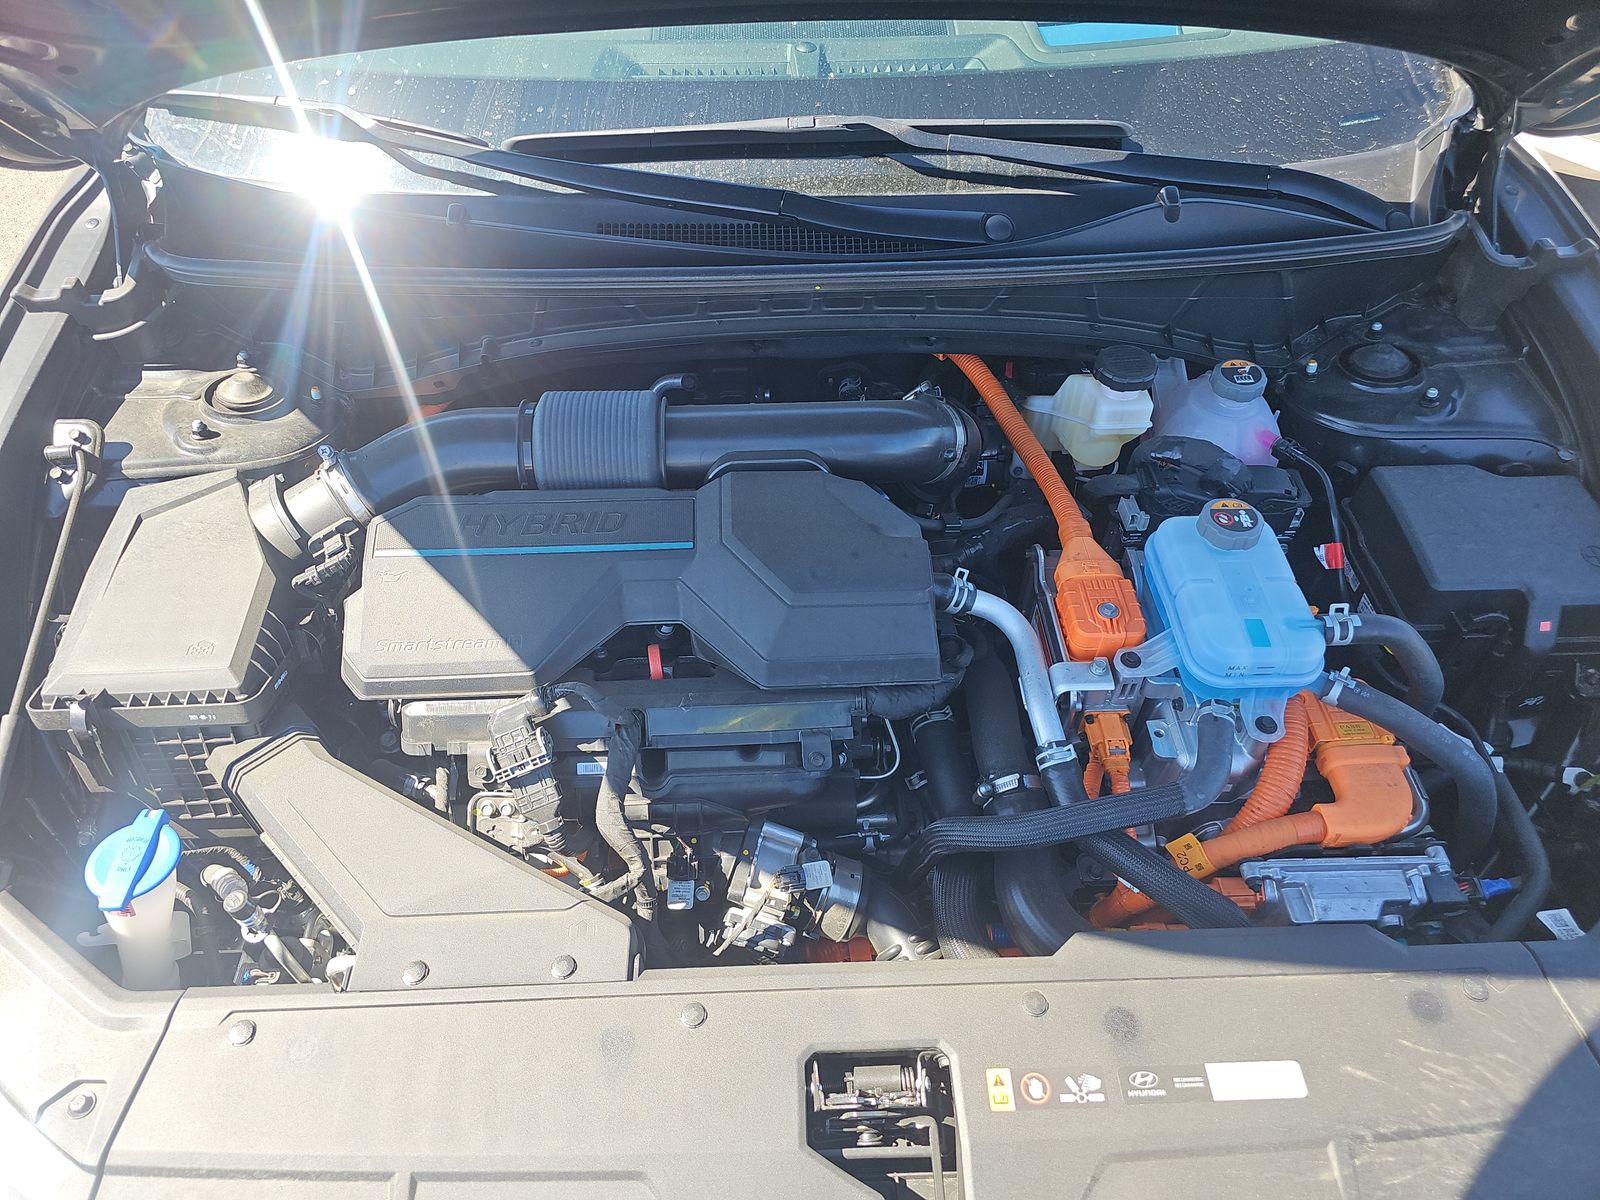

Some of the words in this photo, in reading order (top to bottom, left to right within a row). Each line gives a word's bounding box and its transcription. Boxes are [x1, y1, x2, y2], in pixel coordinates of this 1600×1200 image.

[454, 510, 628, 537] HYBRID
[375, 636, 501, 653] Smartstream
[1176, 850, 1194, 873] PC2
[1127, 1089, 1167, 1097] HYUNDAI
